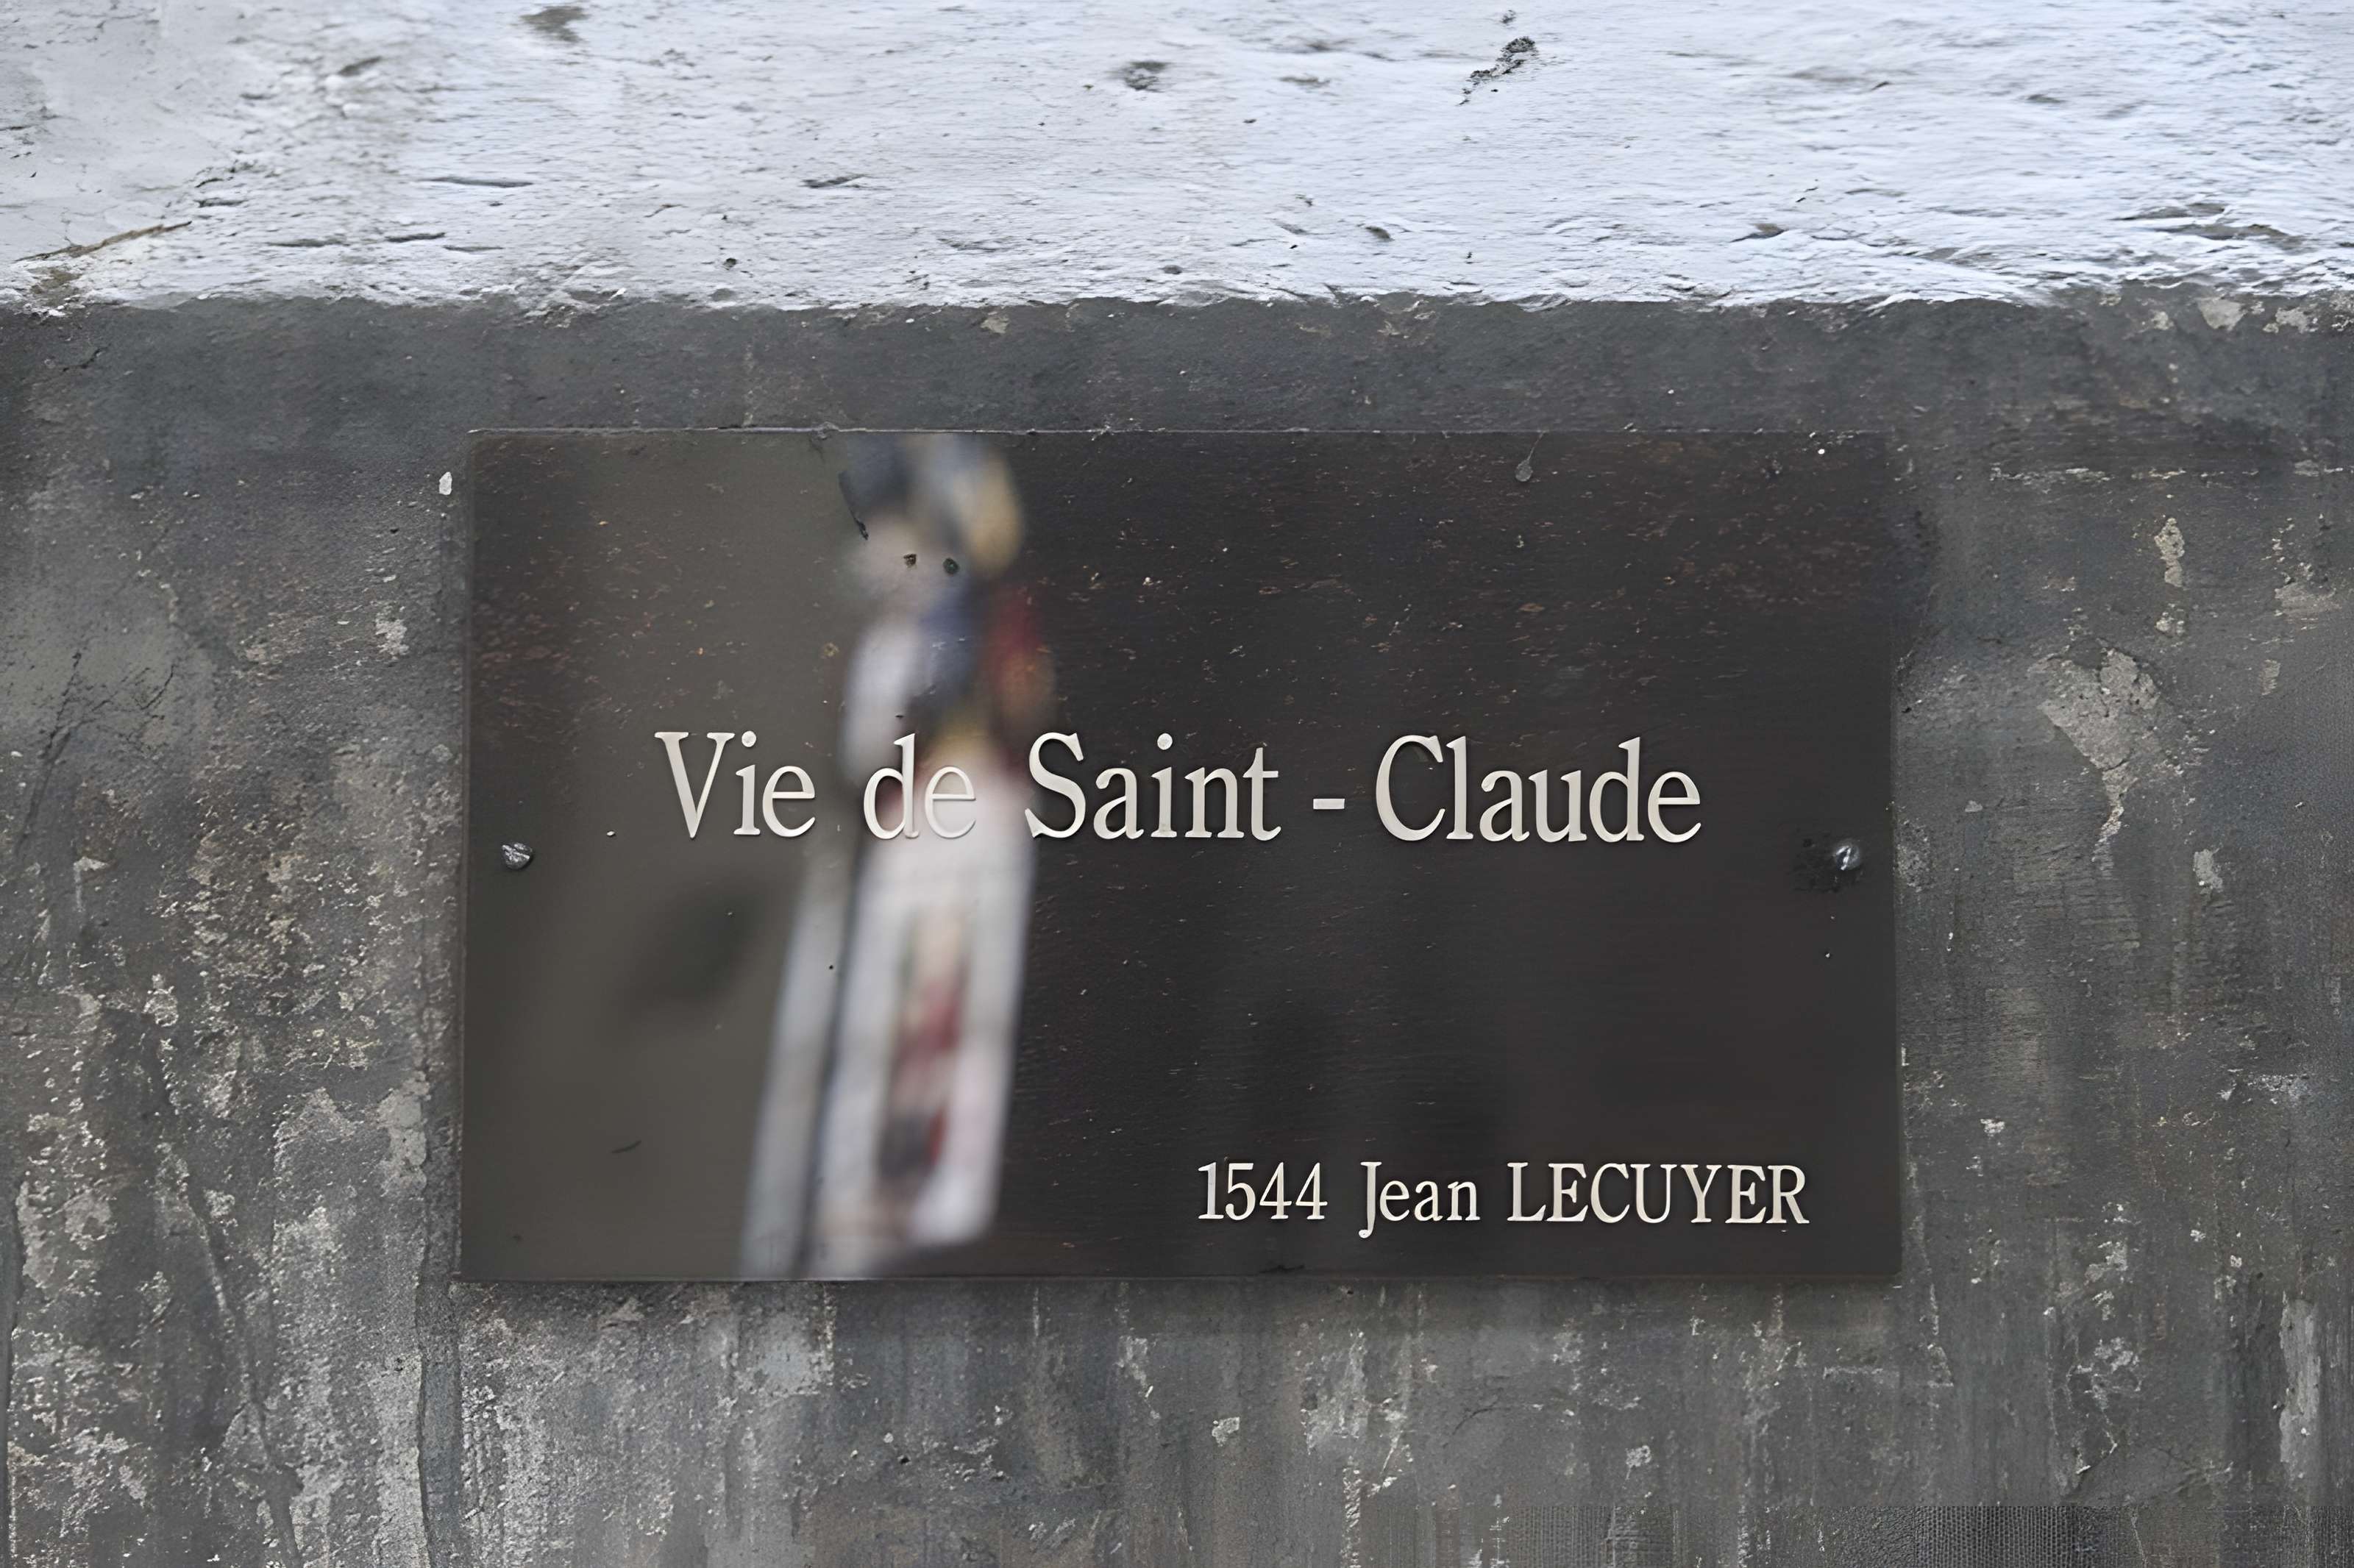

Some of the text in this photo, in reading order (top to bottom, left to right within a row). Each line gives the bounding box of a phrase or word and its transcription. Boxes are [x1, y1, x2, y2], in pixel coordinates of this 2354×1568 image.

[654, 731, 1702, 844] Vie de Saint - Claude
[1197, 1161, 1810, 1239] 1544 Jean LECUYER
